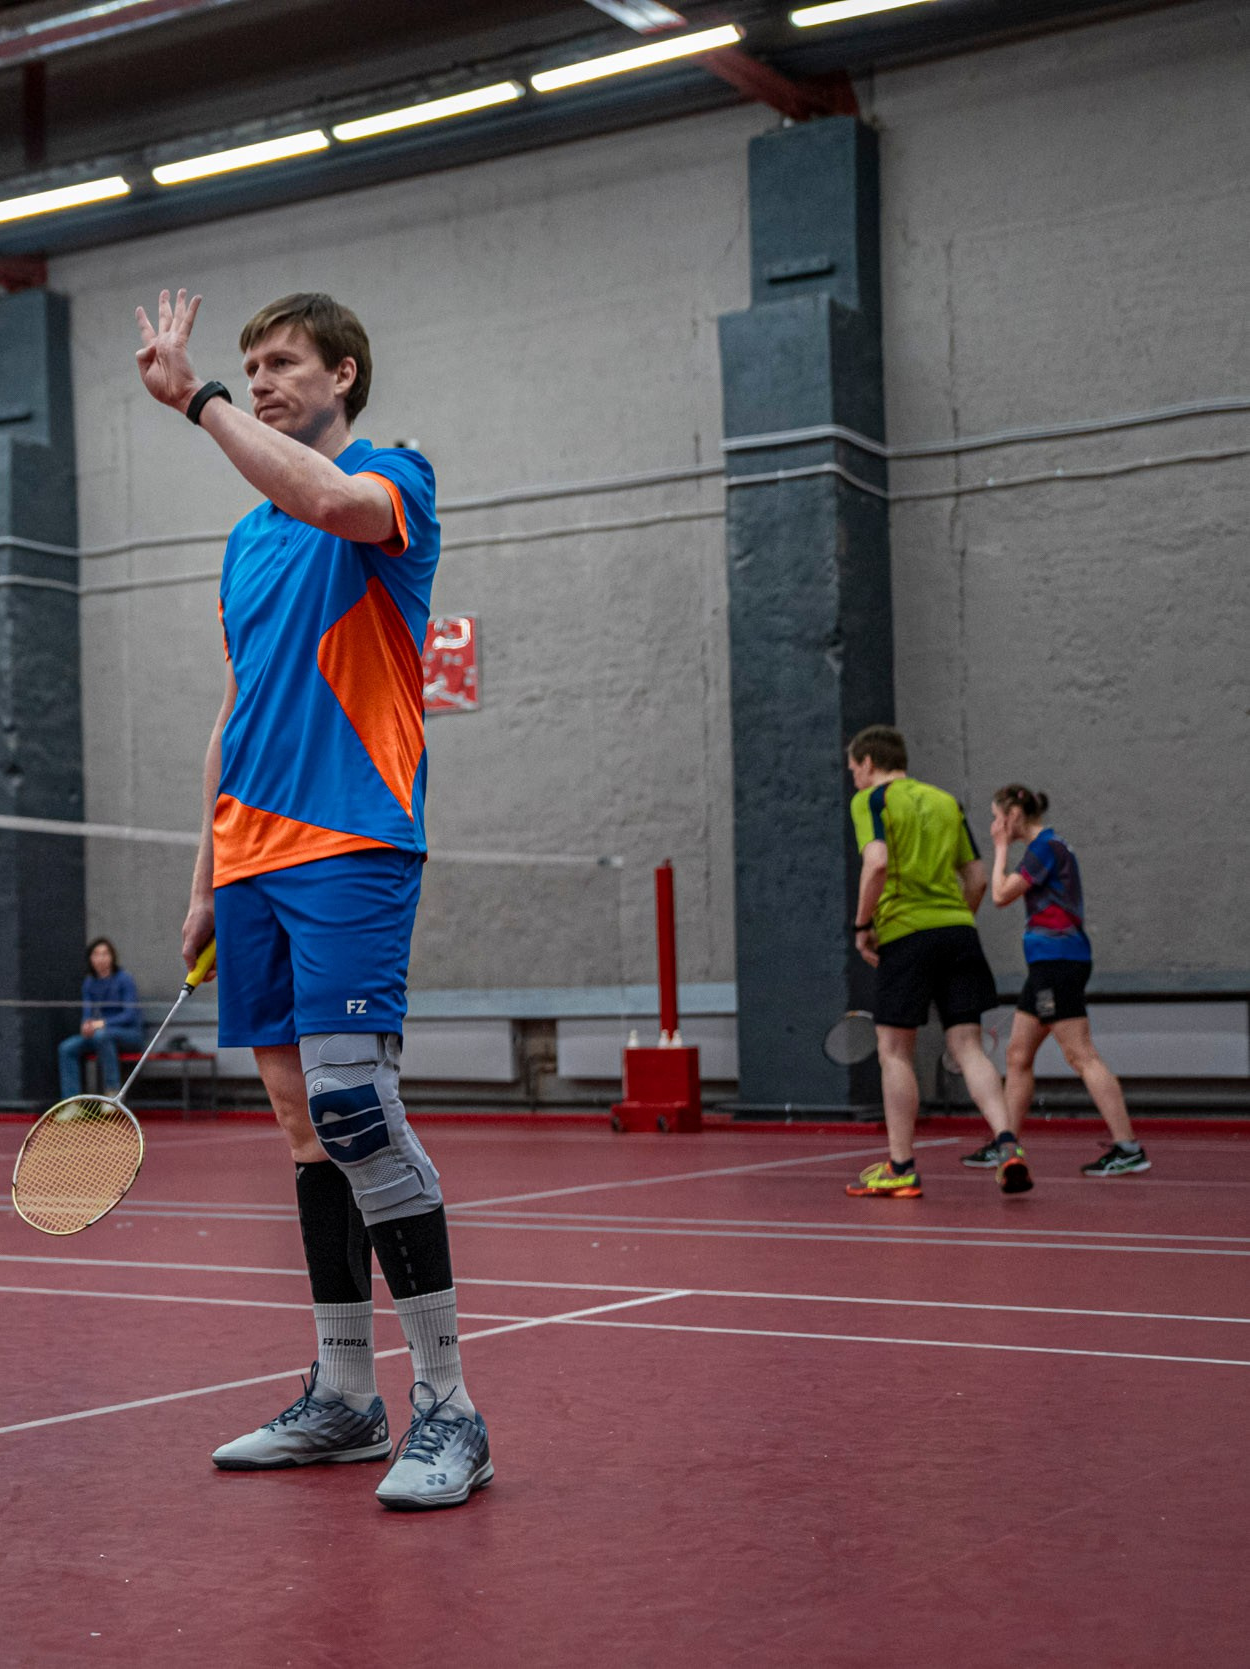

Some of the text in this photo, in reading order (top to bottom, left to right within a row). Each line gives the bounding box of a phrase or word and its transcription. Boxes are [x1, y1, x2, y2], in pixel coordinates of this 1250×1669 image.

[347, 1000, 367, 1014] FZ
[323, 1337, 368, 1347] FZ FORZA
[439, 1335, 450, 1347] FZ
